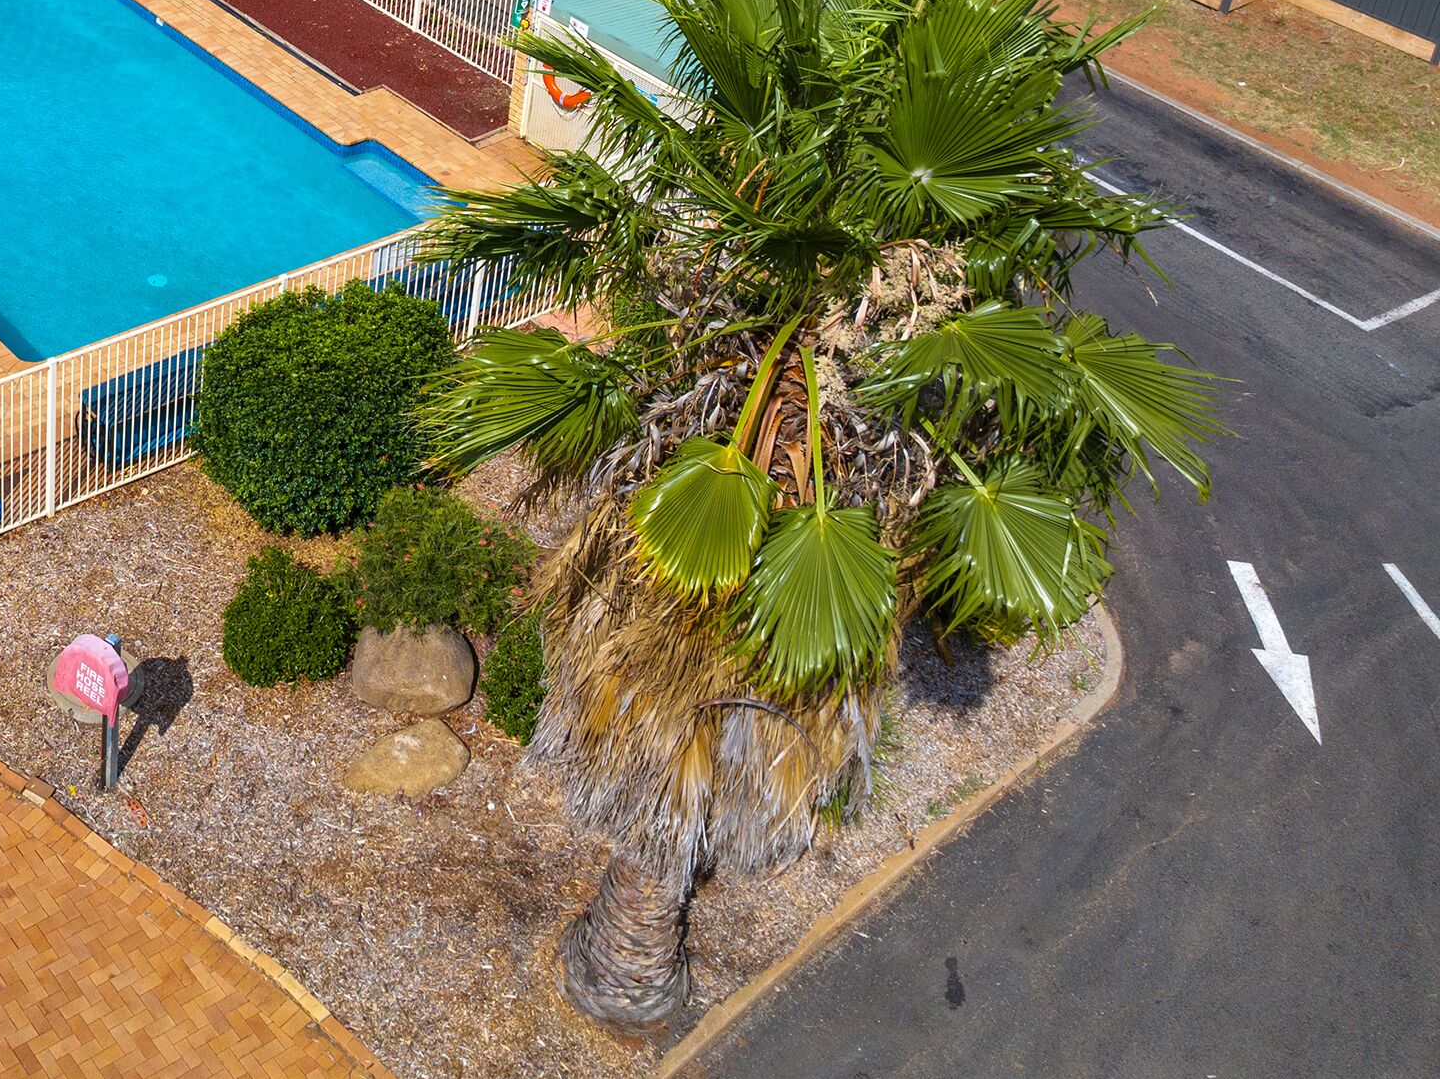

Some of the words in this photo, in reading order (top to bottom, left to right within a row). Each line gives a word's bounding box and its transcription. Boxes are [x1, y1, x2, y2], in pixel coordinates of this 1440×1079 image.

[76, 669, 106, 698] HOSE
[80, 662, 104, 685] FIRE
[75, 681, 103, 707] REEL
